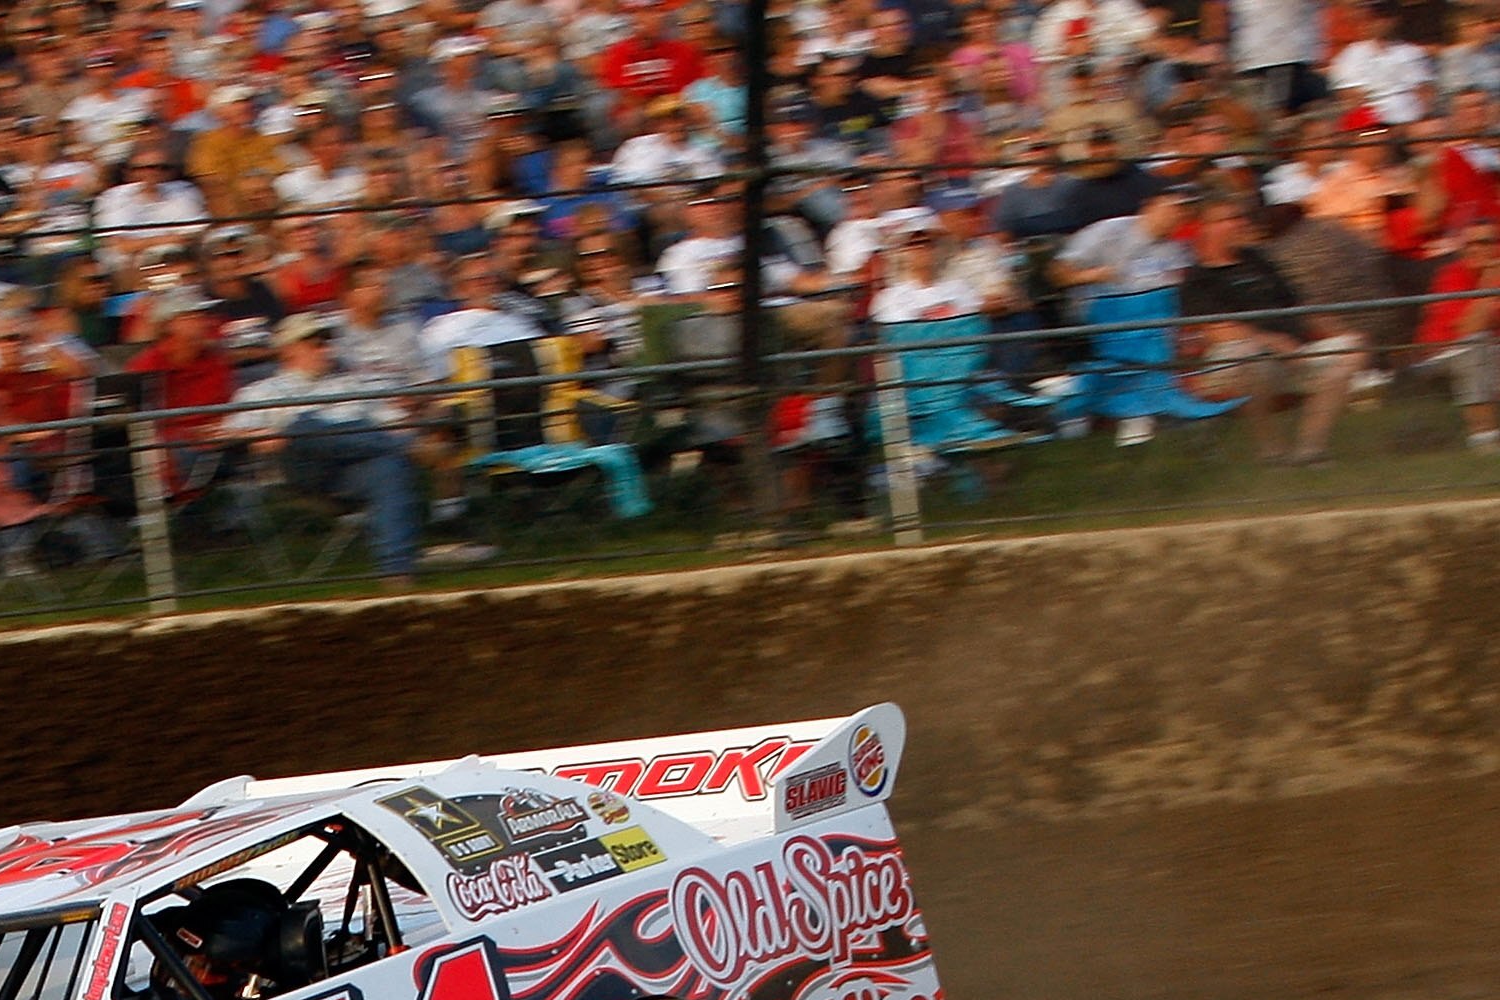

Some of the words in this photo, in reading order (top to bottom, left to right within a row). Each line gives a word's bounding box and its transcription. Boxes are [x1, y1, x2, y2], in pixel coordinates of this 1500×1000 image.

[611, 841, 657, 864] Store
[672, 866, 798, 989] Old
[783, 835, 914, 969] Spice
